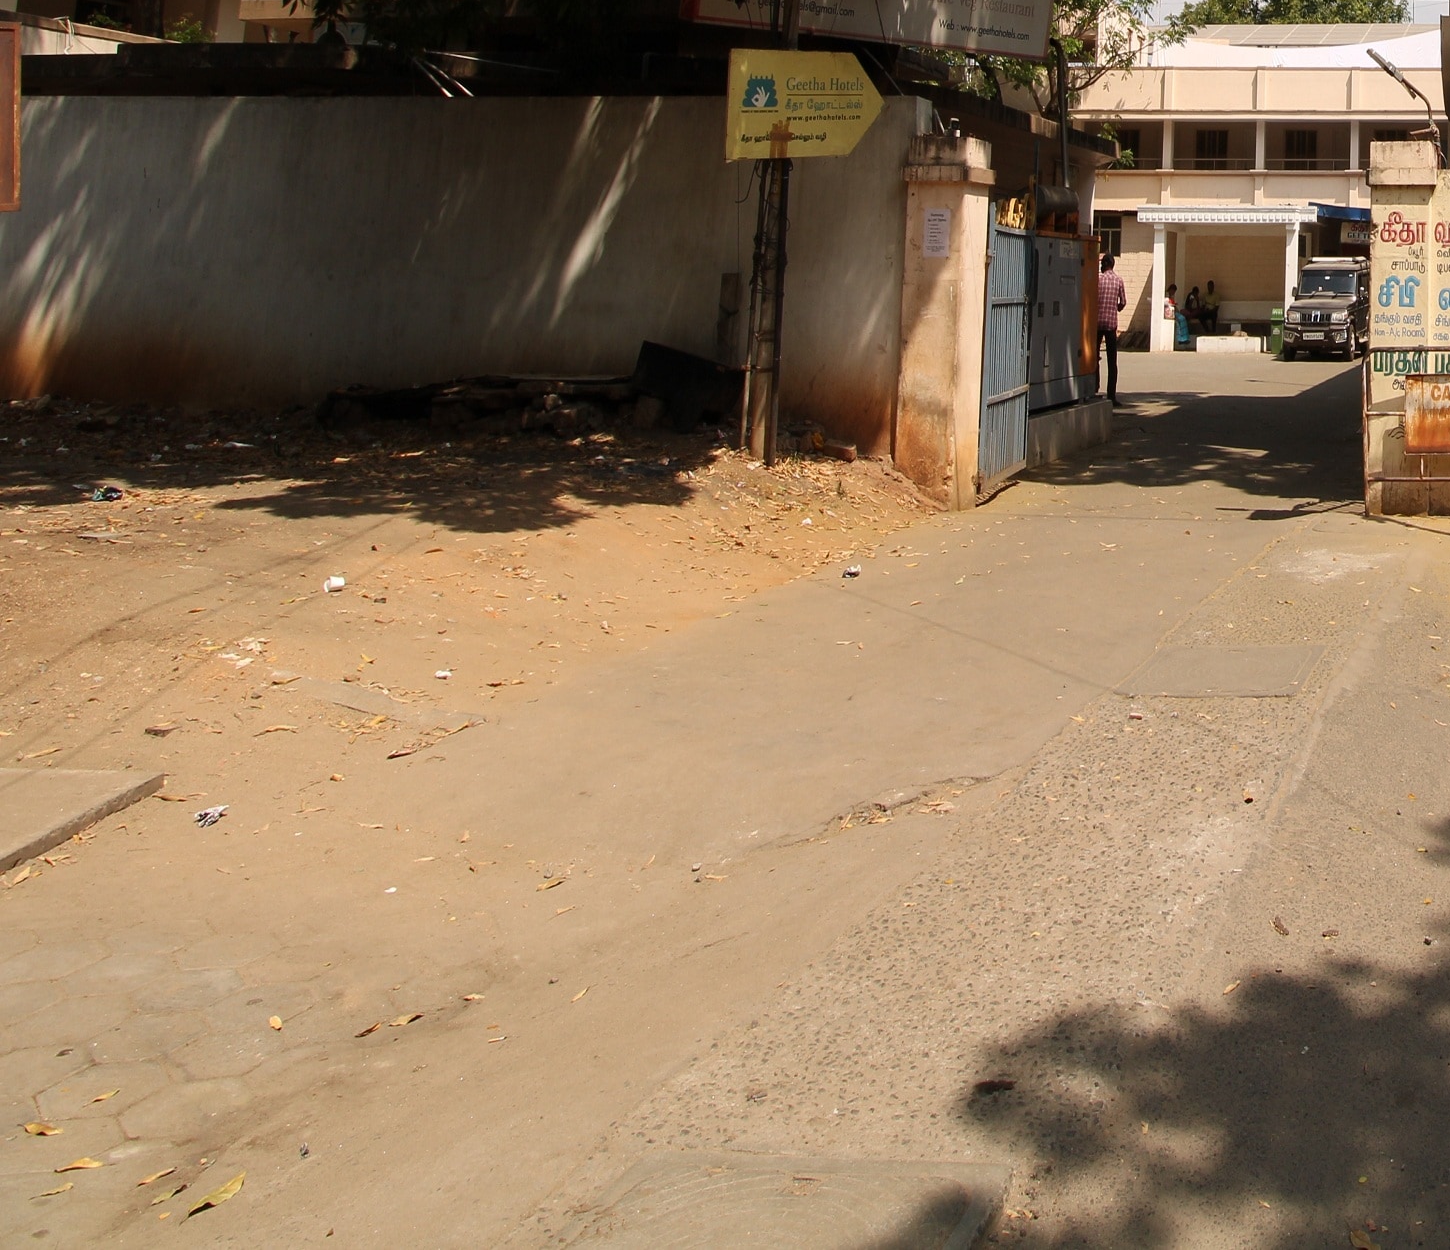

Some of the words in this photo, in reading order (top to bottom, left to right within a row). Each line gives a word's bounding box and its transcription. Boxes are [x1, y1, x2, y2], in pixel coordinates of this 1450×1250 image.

[939, 19, 955, 30] Web
[960, 25, 1030, 41] www.geethahotels.com
[786, 77, 826, 91] Geetha
[830, 77, 865, 91] Hotels
[786, 114, 861, 122] www.geethahotels.com
[1380, 210, 1427, 248] கீதா
